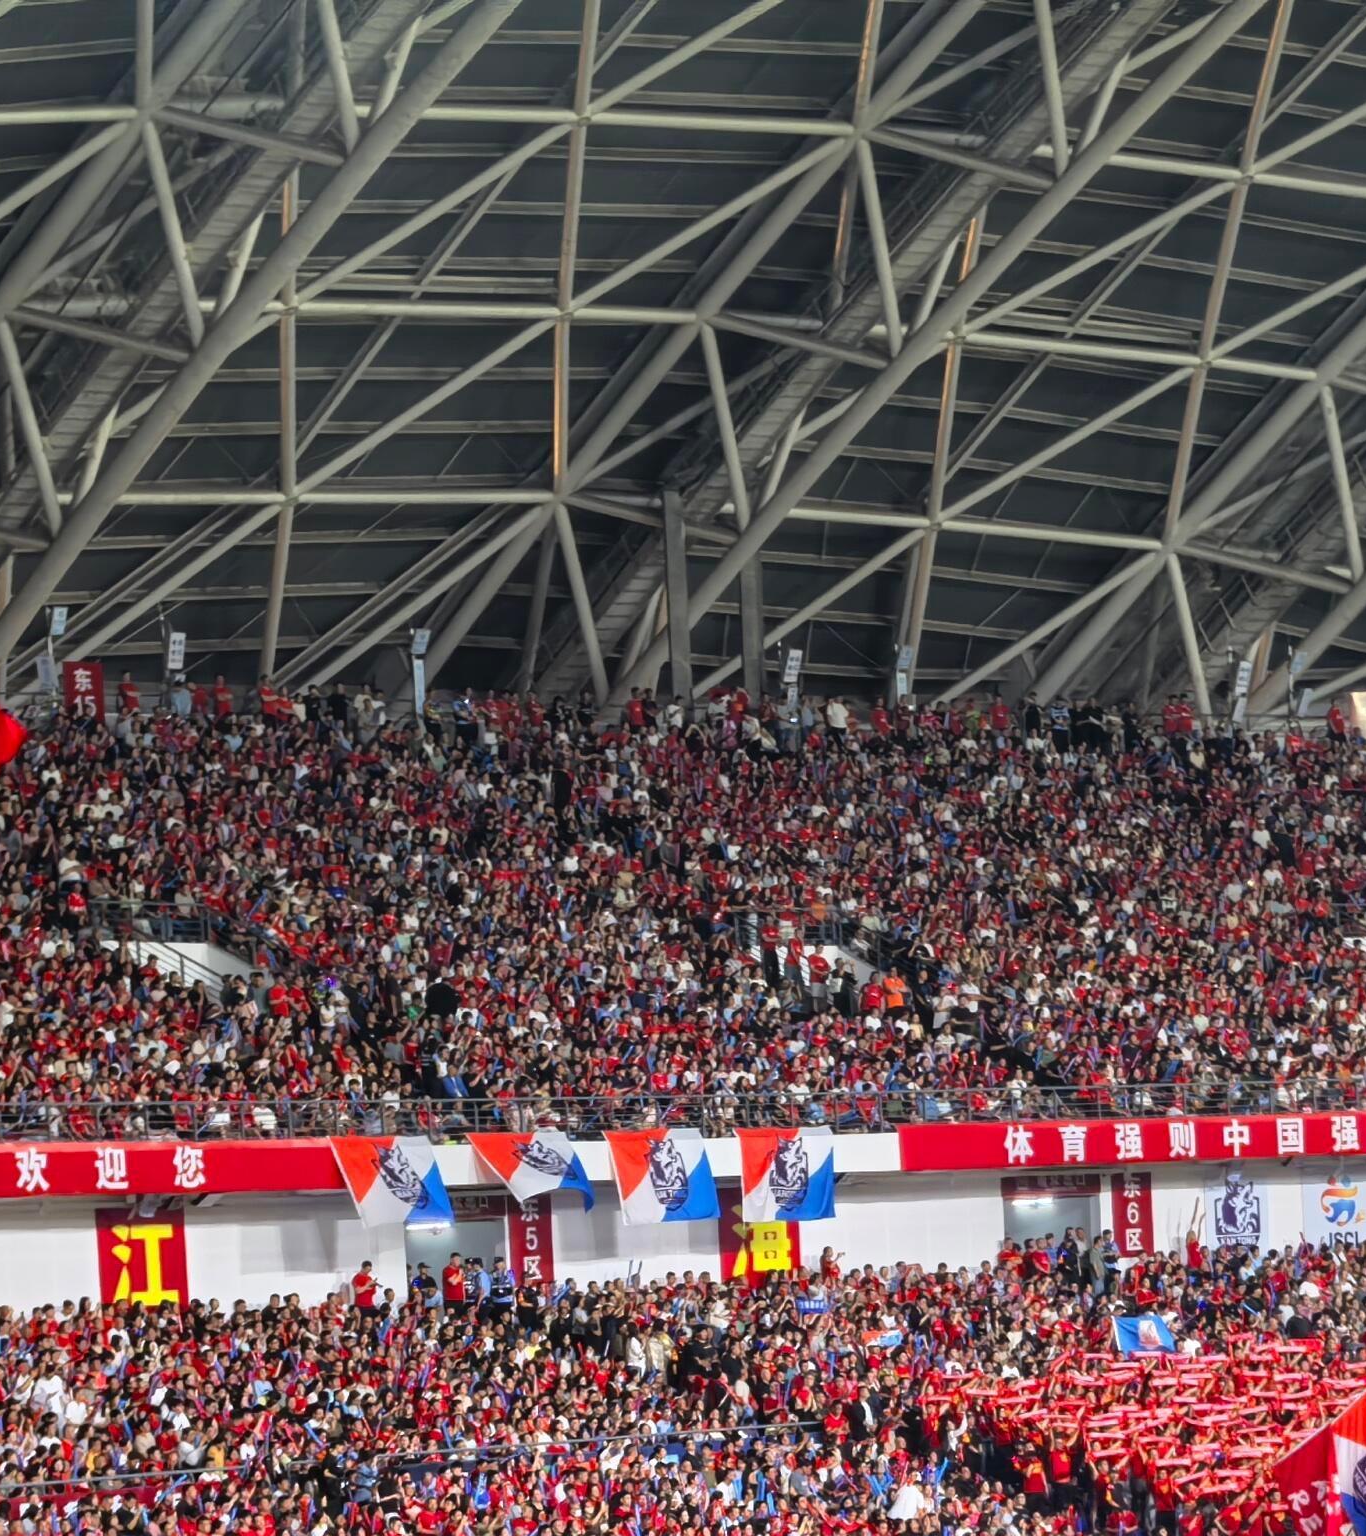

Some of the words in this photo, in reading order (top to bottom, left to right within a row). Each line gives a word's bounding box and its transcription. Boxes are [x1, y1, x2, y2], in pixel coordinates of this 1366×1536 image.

[1003, 1115, 1361, 1165] 体育强则中国强
[112, 1223, 180, 1307] 江
